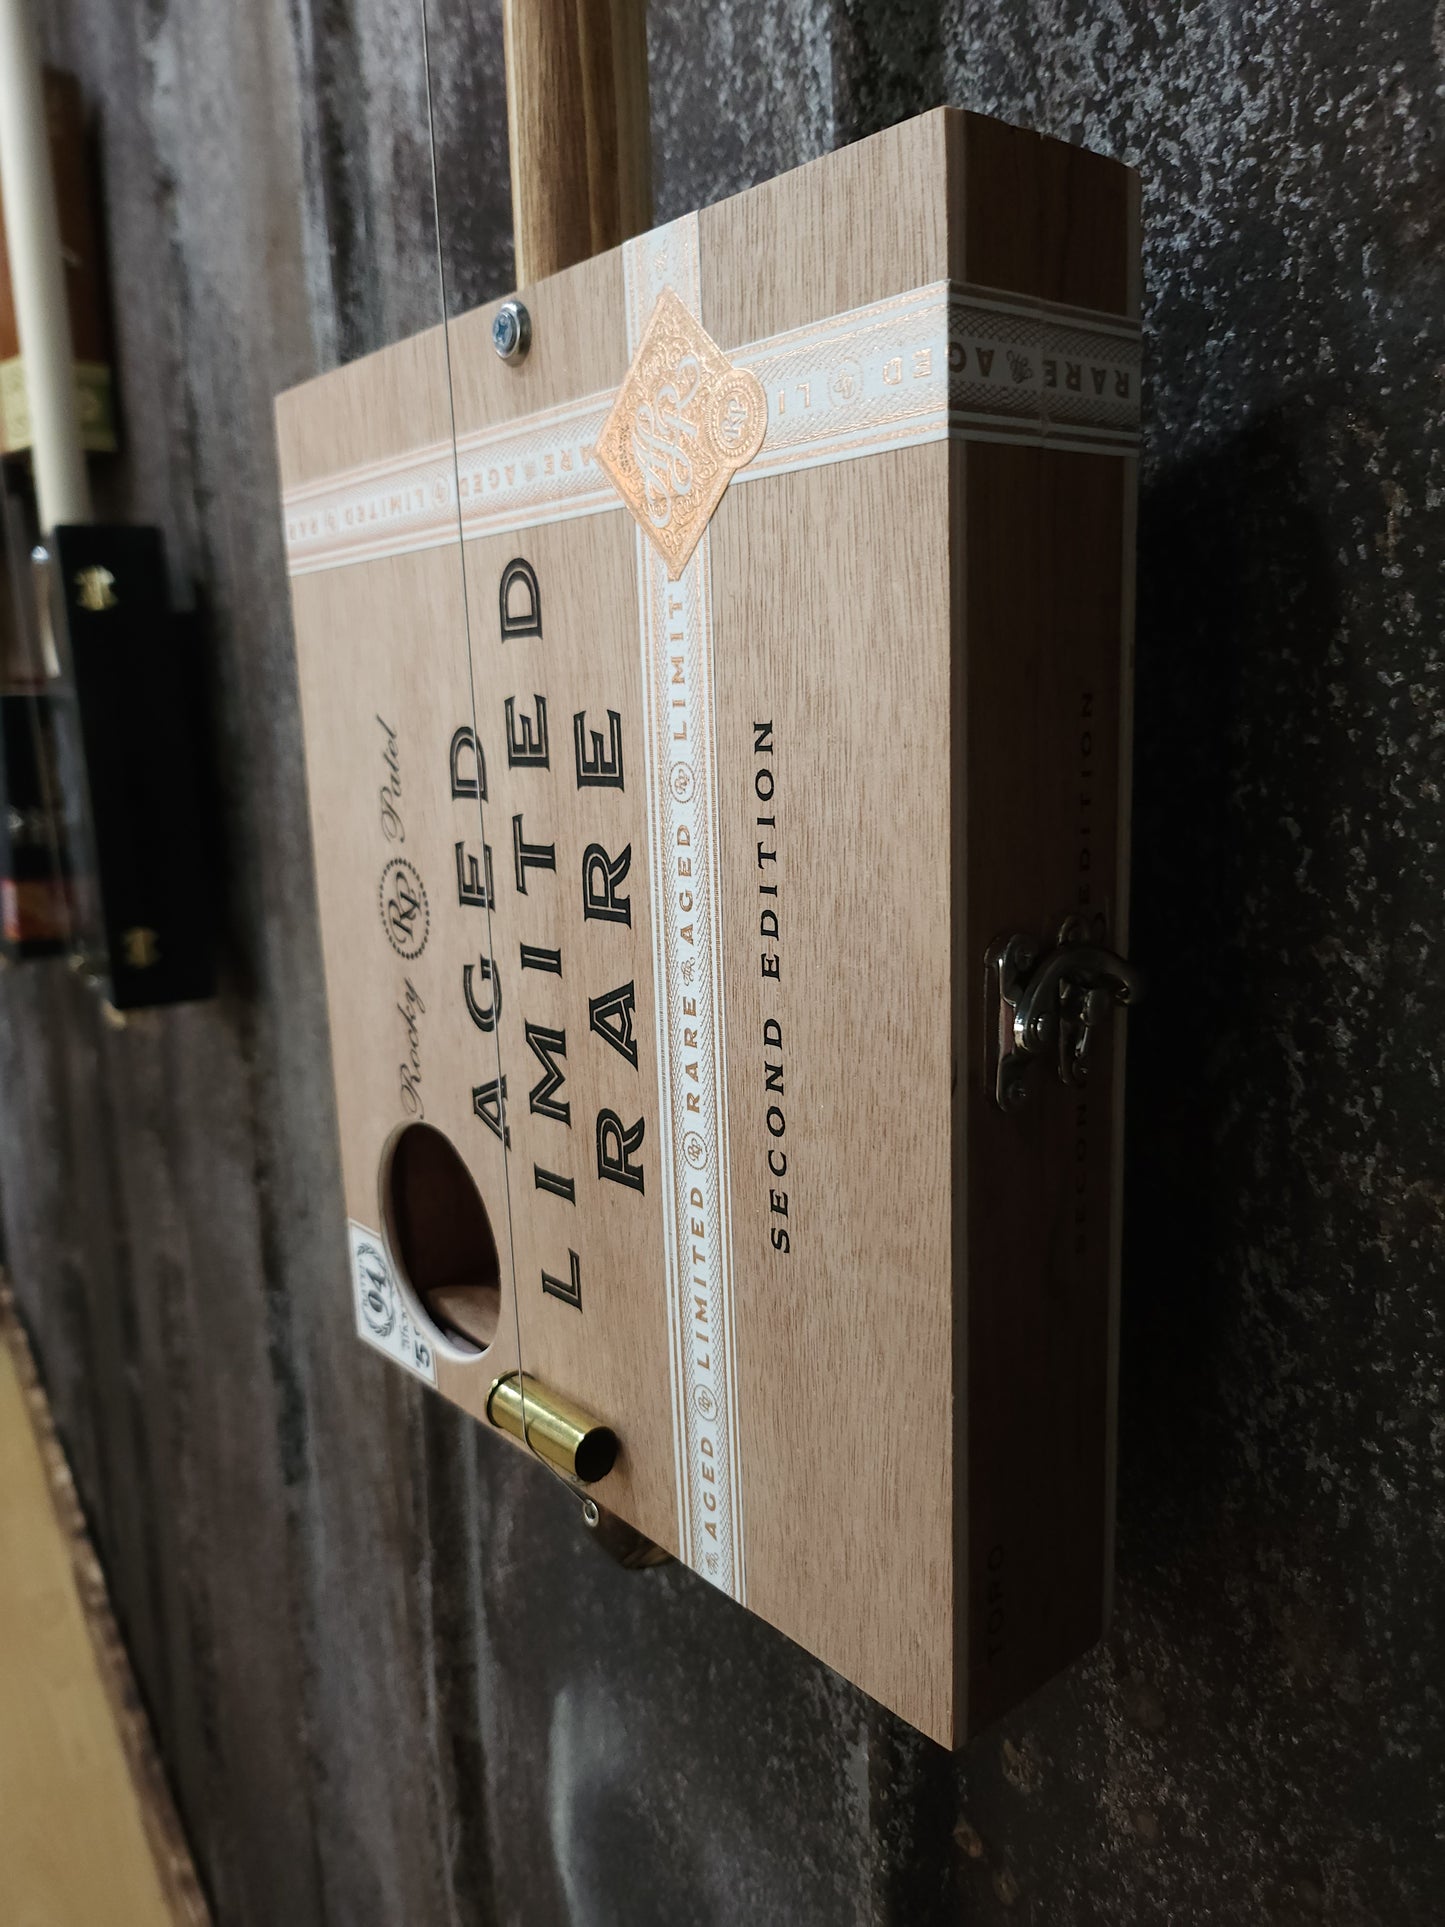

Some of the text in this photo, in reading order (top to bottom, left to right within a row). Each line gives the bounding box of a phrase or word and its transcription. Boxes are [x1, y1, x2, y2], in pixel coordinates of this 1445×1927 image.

[1042, 359, 1130, 399] RARE
[345, 488, 425, 526] LIMITED
[459, 464, 516, 498] AGED
[543, 443, 597, 477] ARE
[669, 595, 688, 742] LIMIT
[376, 713, 405, 843] Patel
[1077, 691, 1095, 906] EDITION
[449, 725, 512, 1152] AGED
[499, 556, 583, 1314] LIMITED
[573, 707, 646, 1198] RARE
[677, 824, 694, 946] AGED
[397, 976, 427, 1120] Rocky
[682, 996, 701, 1112] RARE
[753, 719, 790, 1254] SECOND EDITION
[690, 1187, 710, 1371] LIMITED
[701, 1436, 718, 1542] AGED
